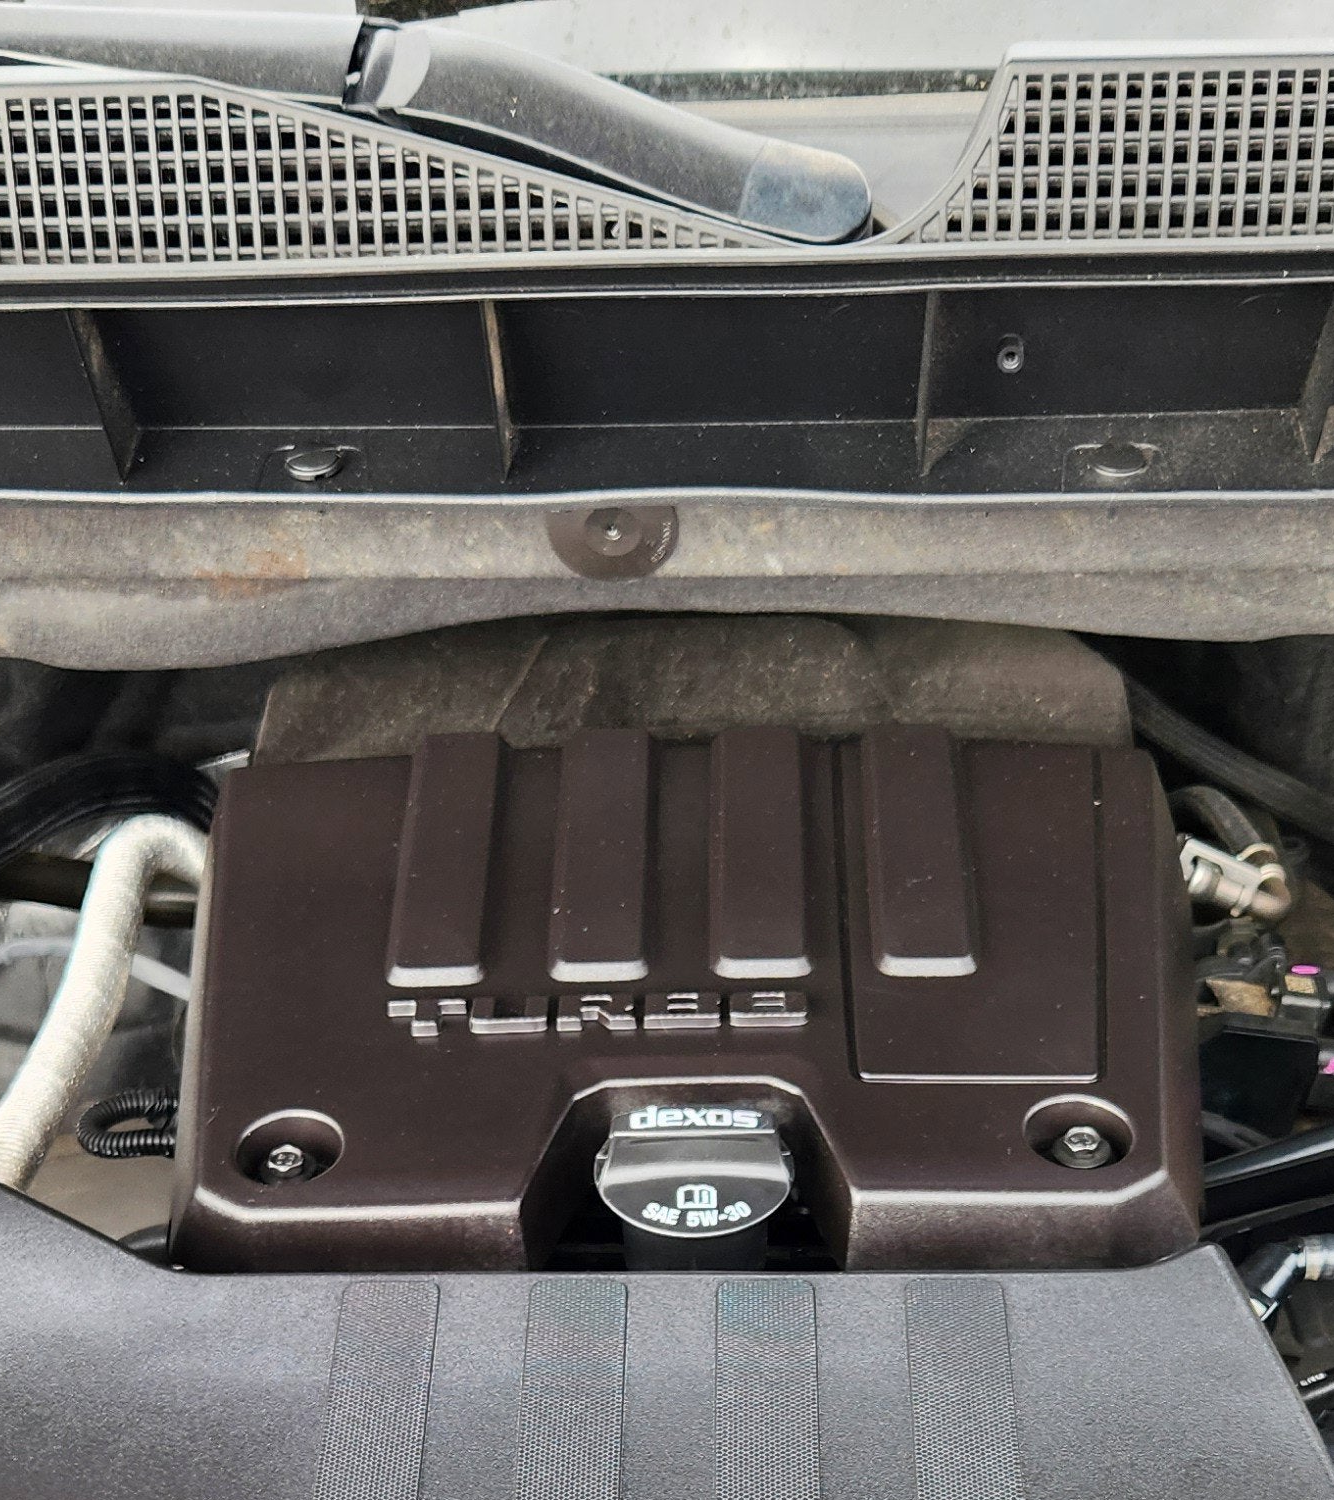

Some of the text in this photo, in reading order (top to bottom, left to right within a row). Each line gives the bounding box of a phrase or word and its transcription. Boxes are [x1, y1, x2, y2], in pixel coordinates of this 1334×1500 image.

[385, 991, 810, 1038] TURBO
[628, 1105, 763, 1130] dexos
[641, 1200, 753, 1228] SAE 5W-30
